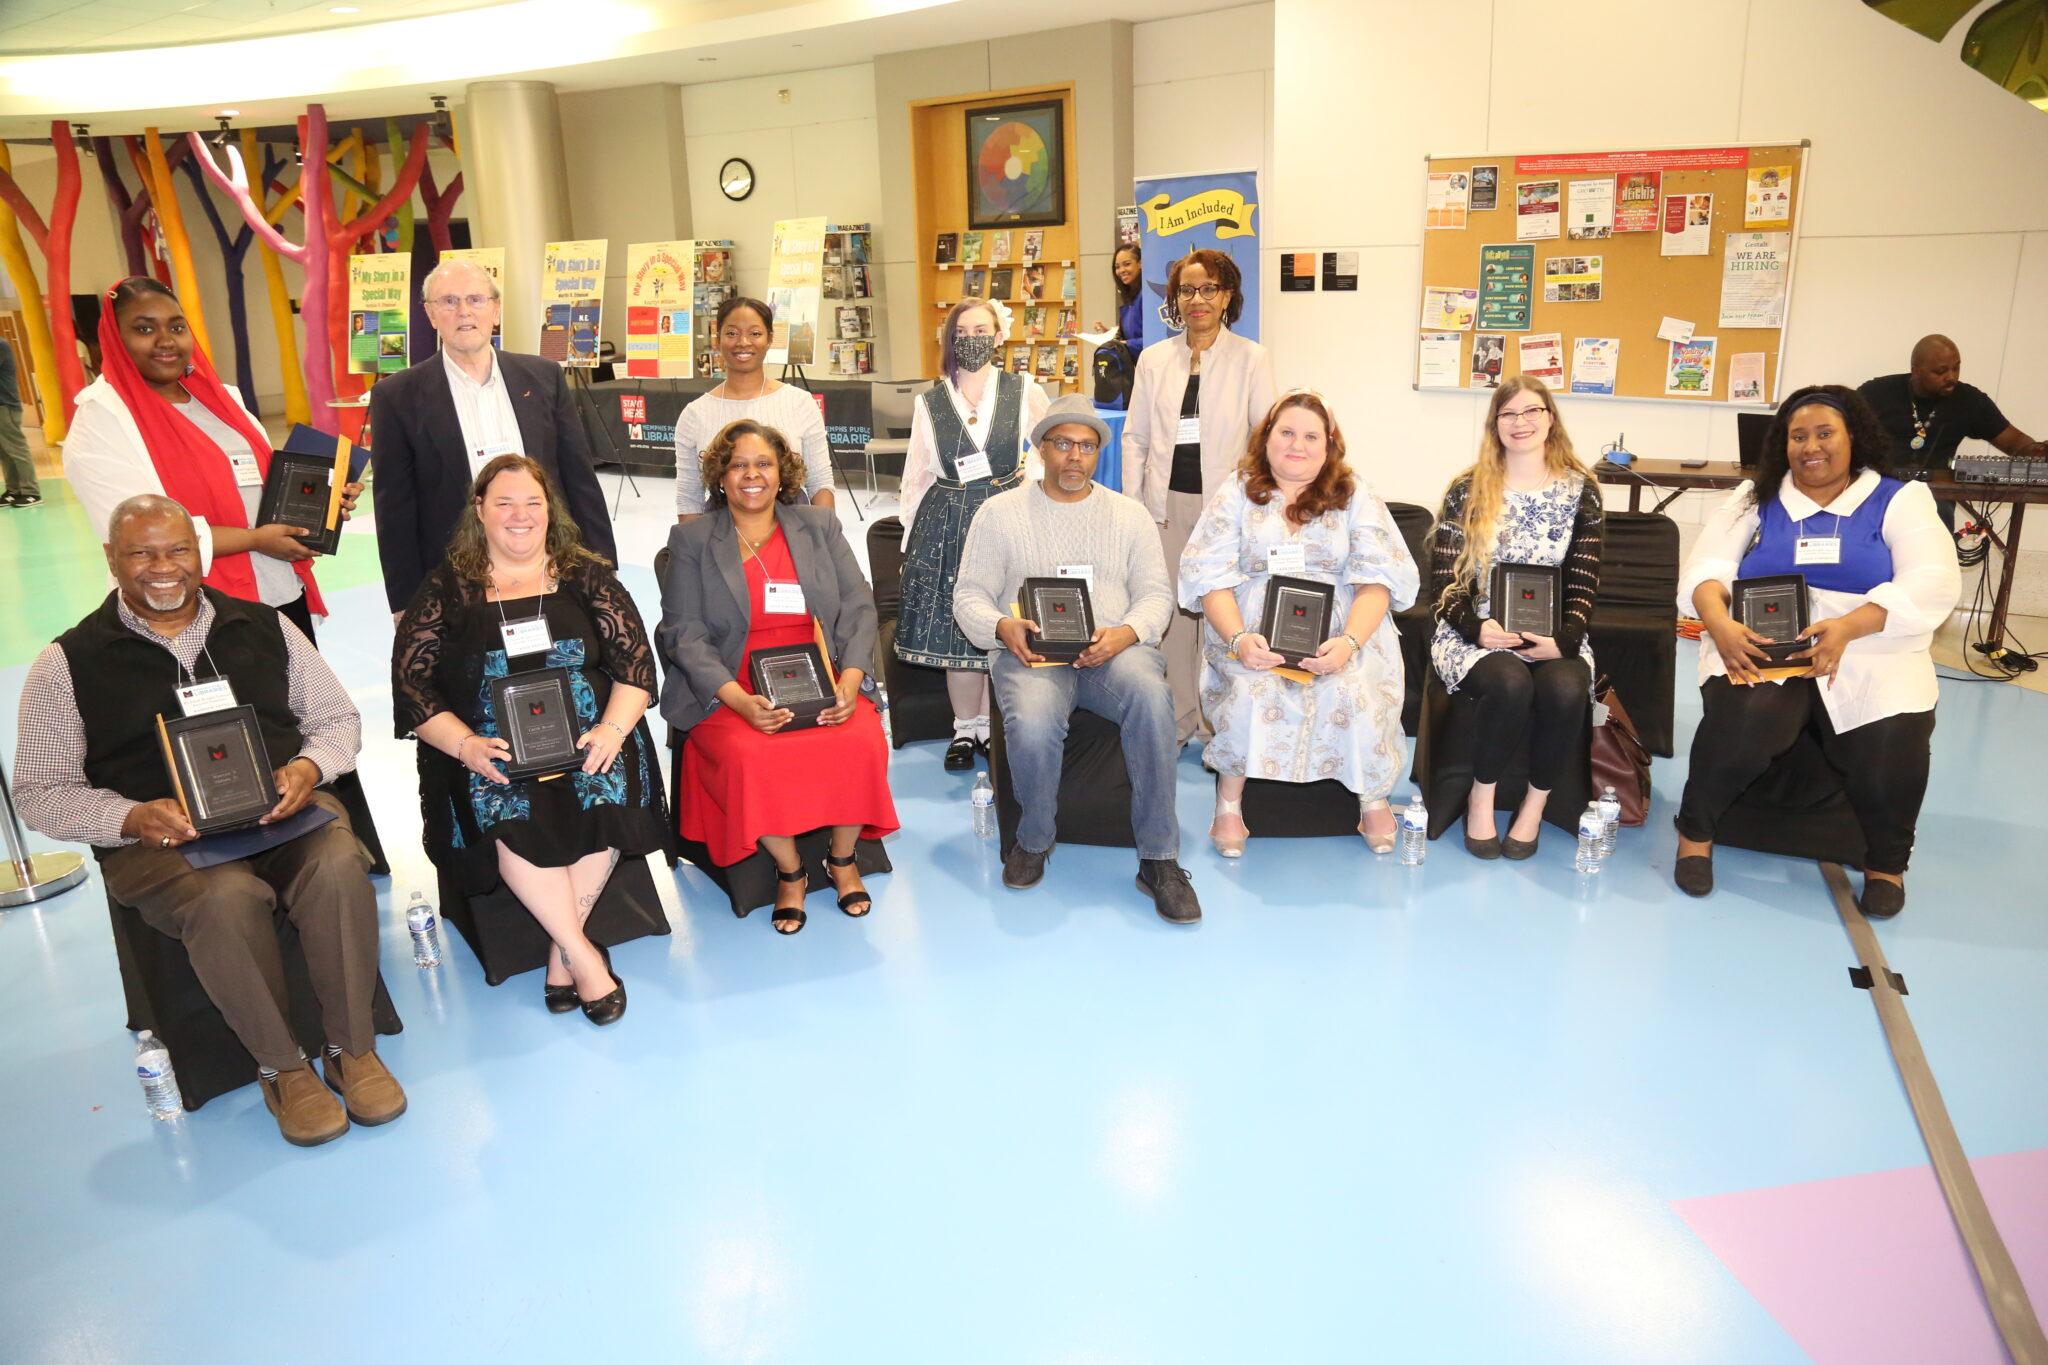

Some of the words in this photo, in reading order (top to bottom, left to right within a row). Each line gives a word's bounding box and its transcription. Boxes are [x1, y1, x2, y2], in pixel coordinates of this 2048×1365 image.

[1622, 185, 1655, 201] HEIGHTS
[1160, 217, 1164, 229] I
[1167, 216, 1184, 229] Am
[1185, 200, 1234, 221] Included
[1736, 252, 1753, 260] WE
[1755, 251, 1776, 260] ARE
[1731, 260, 1780, 271] HIRING
[362, 271, 372, 284] My
[374, 270, 390, 283] Story
[392, 269, 398, 281] in
[400, 271, 405, 281] a
[362, 288, 386, 301] Special
[388, 288, 401, 301] Way
[643, 431, 675, 442] LIBRAR
